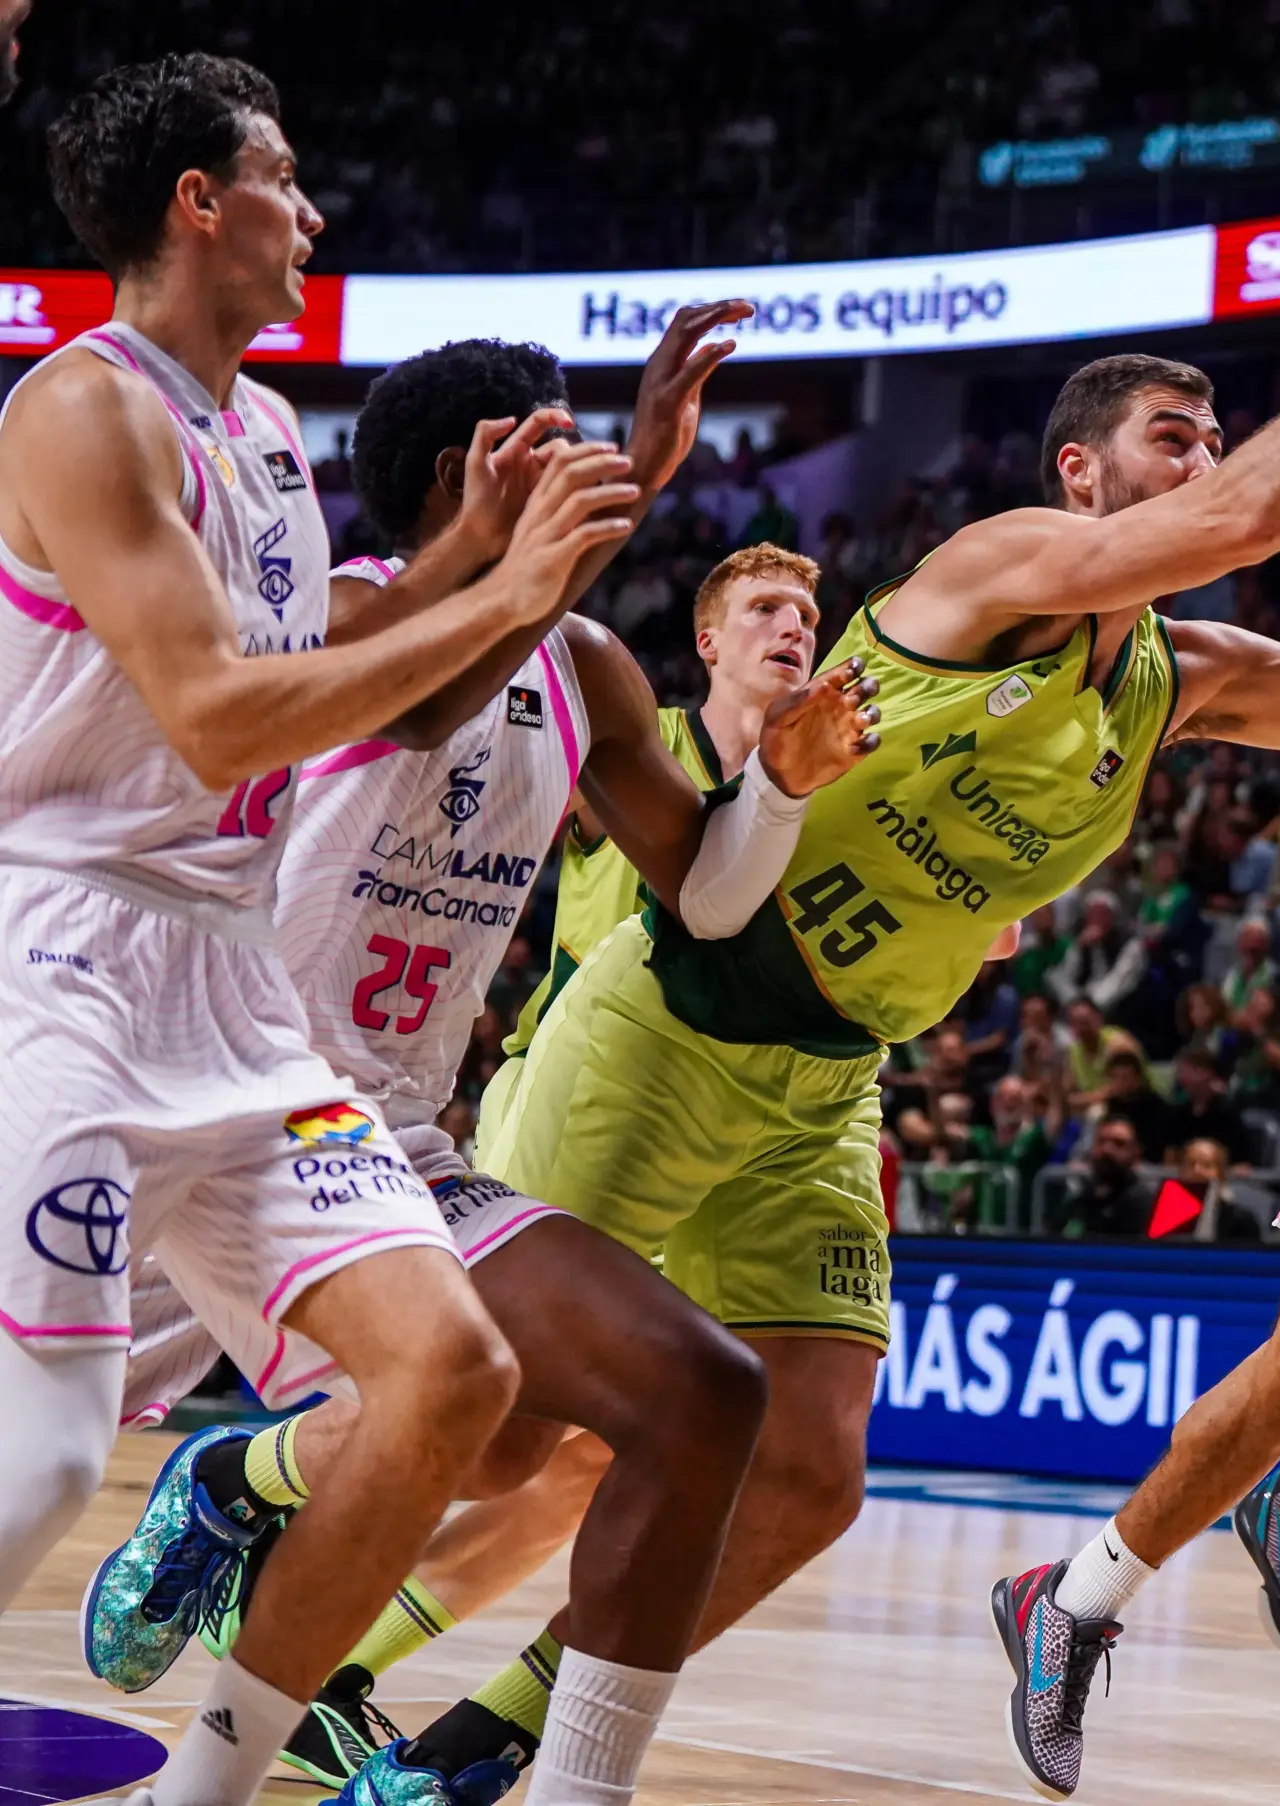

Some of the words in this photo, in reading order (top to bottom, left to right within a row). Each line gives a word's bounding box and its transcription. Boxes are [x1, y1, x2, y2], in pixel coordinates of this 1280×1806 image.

[836, 272, 1009, 338] equipo
[510, 696, 526, 712] liga
[510, 711, 542, 725] endesa
[950, 765, 1050, 867] Unicaja
[788, 862, 904, 968] 45
[352, 934, 451, 1035] 25
[310, 1179, 363, 1213] del
[818, 1223, 867, 1241] sabor
